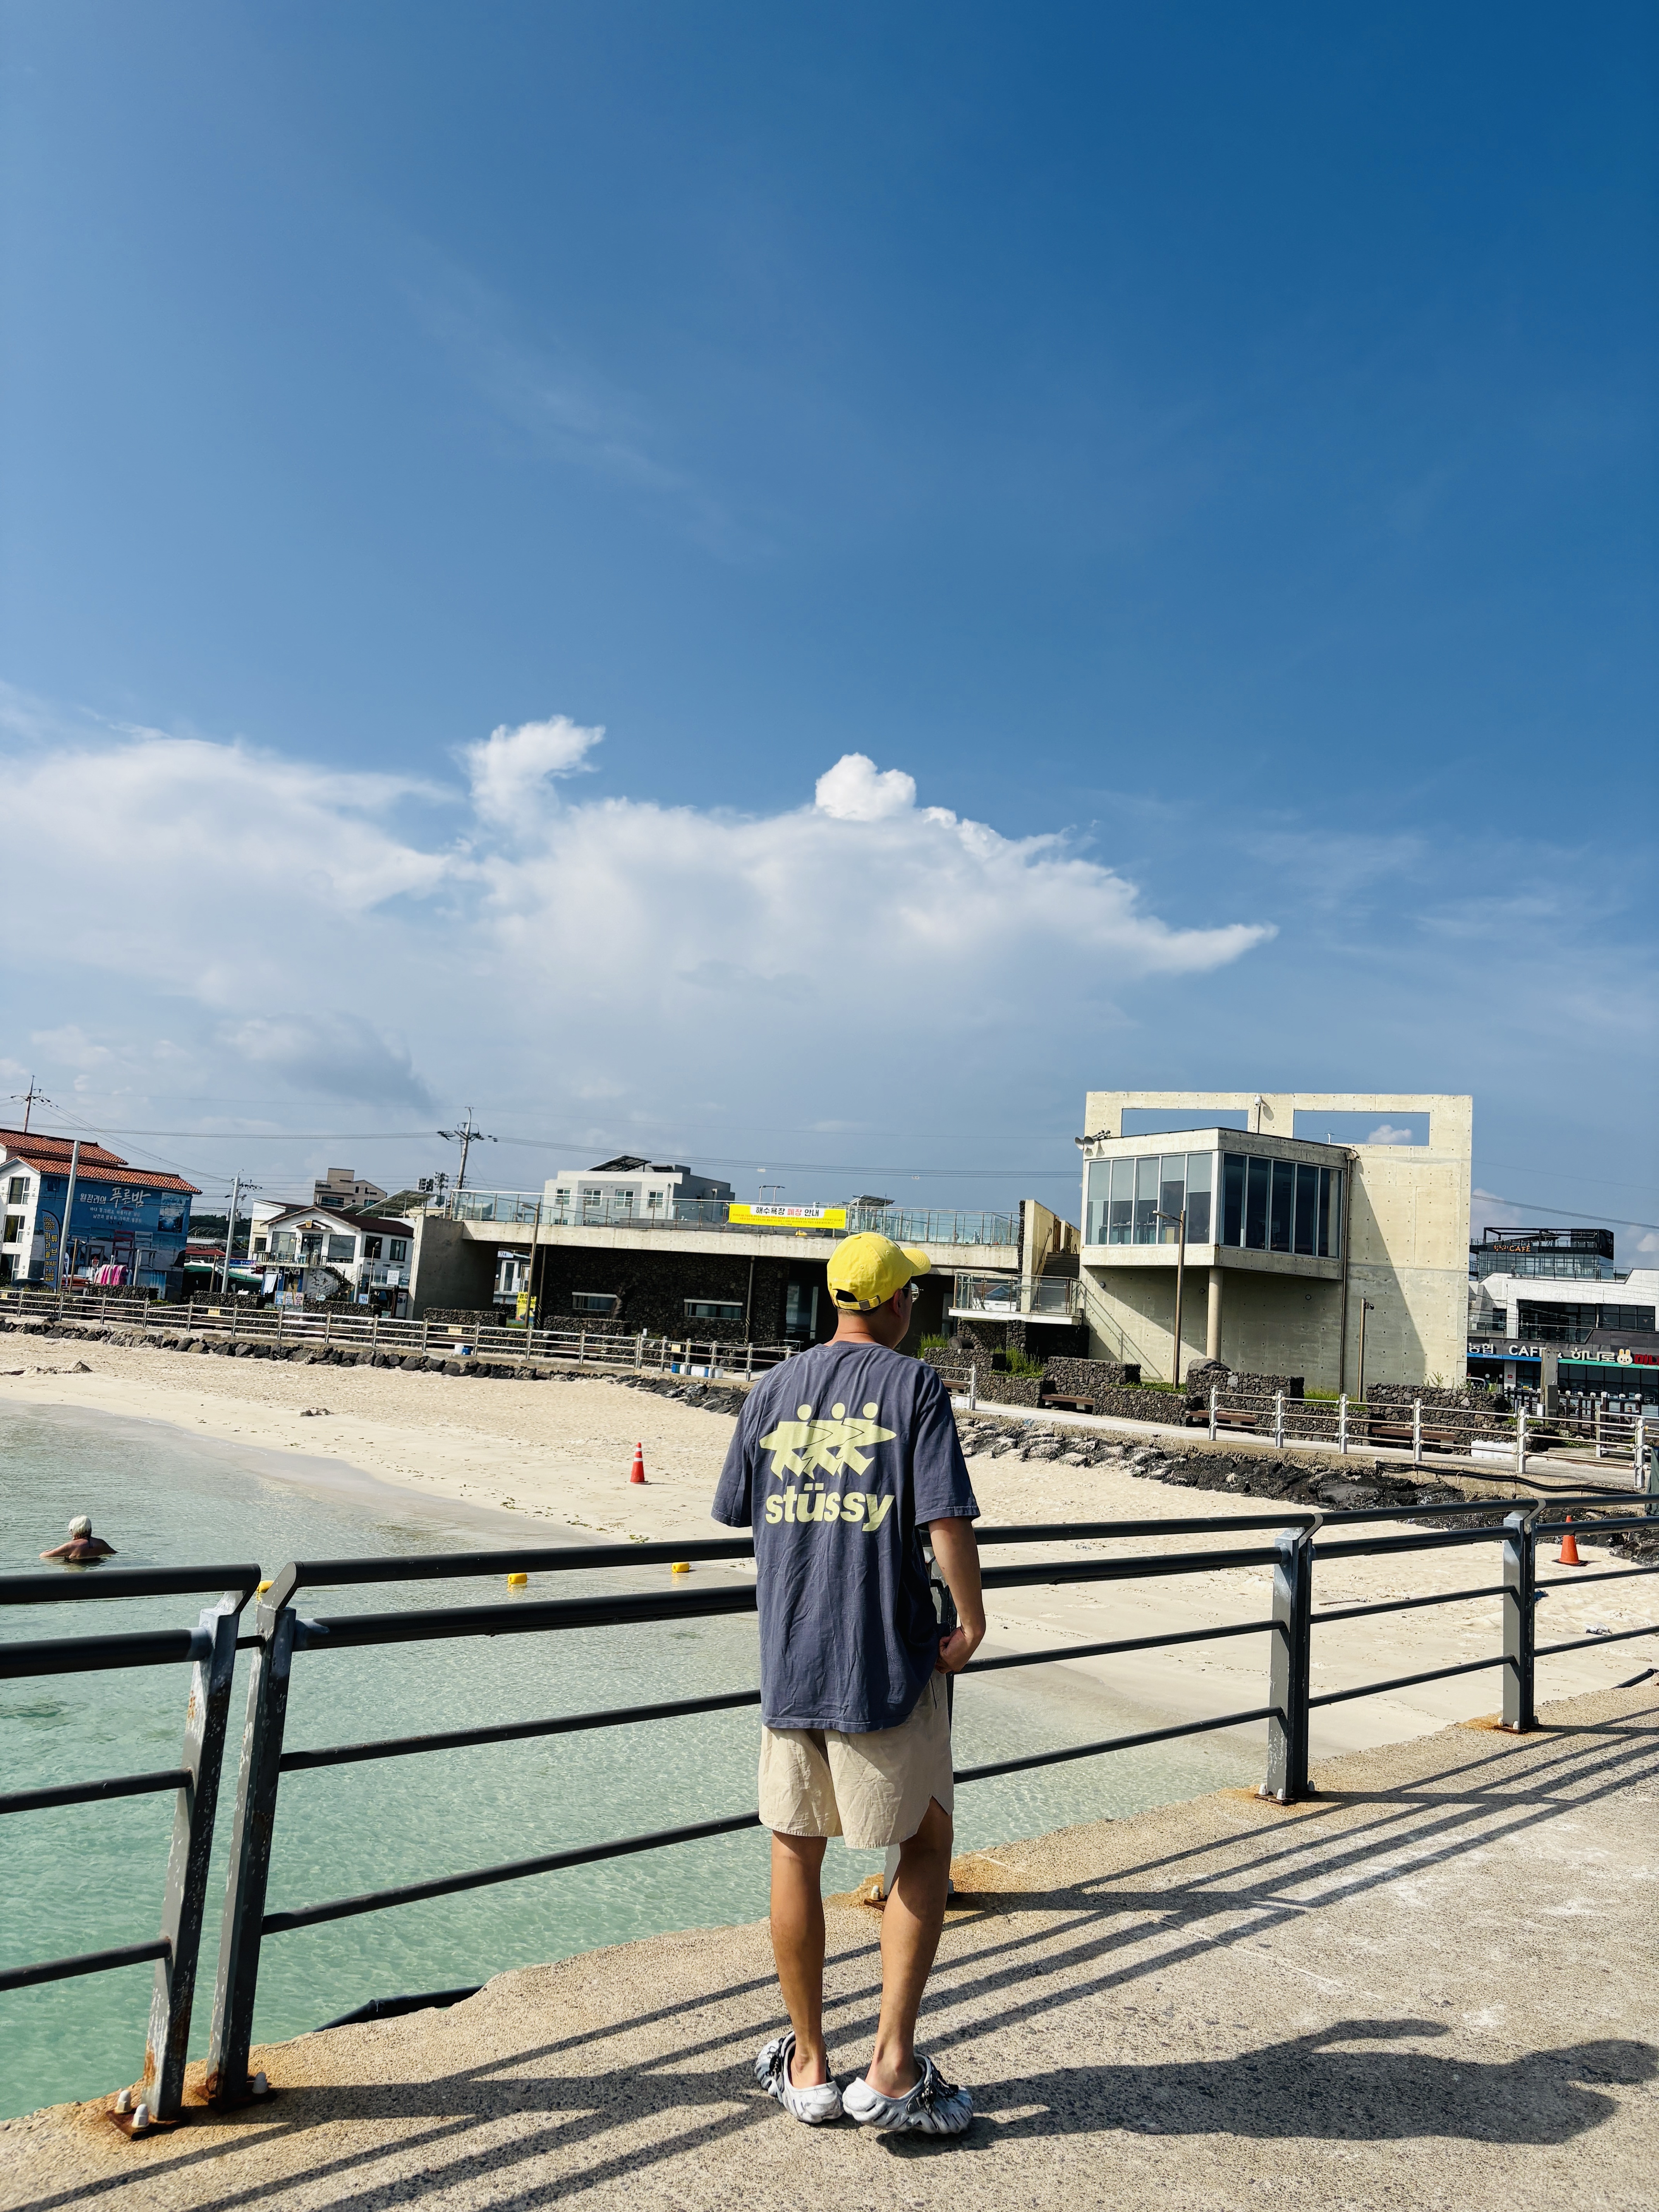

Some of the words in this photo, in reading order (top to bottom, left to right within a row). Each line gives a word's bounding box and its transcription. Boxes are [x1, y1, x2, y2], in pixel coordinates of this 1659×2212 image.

[110, 1187, 151, 1209] 푸른밤
[756, 1207, 785, 1215] 해수욕장
[1468, 1343, 1494, 1355] 농협
[765, 1482, 895, 1532] stüssy
